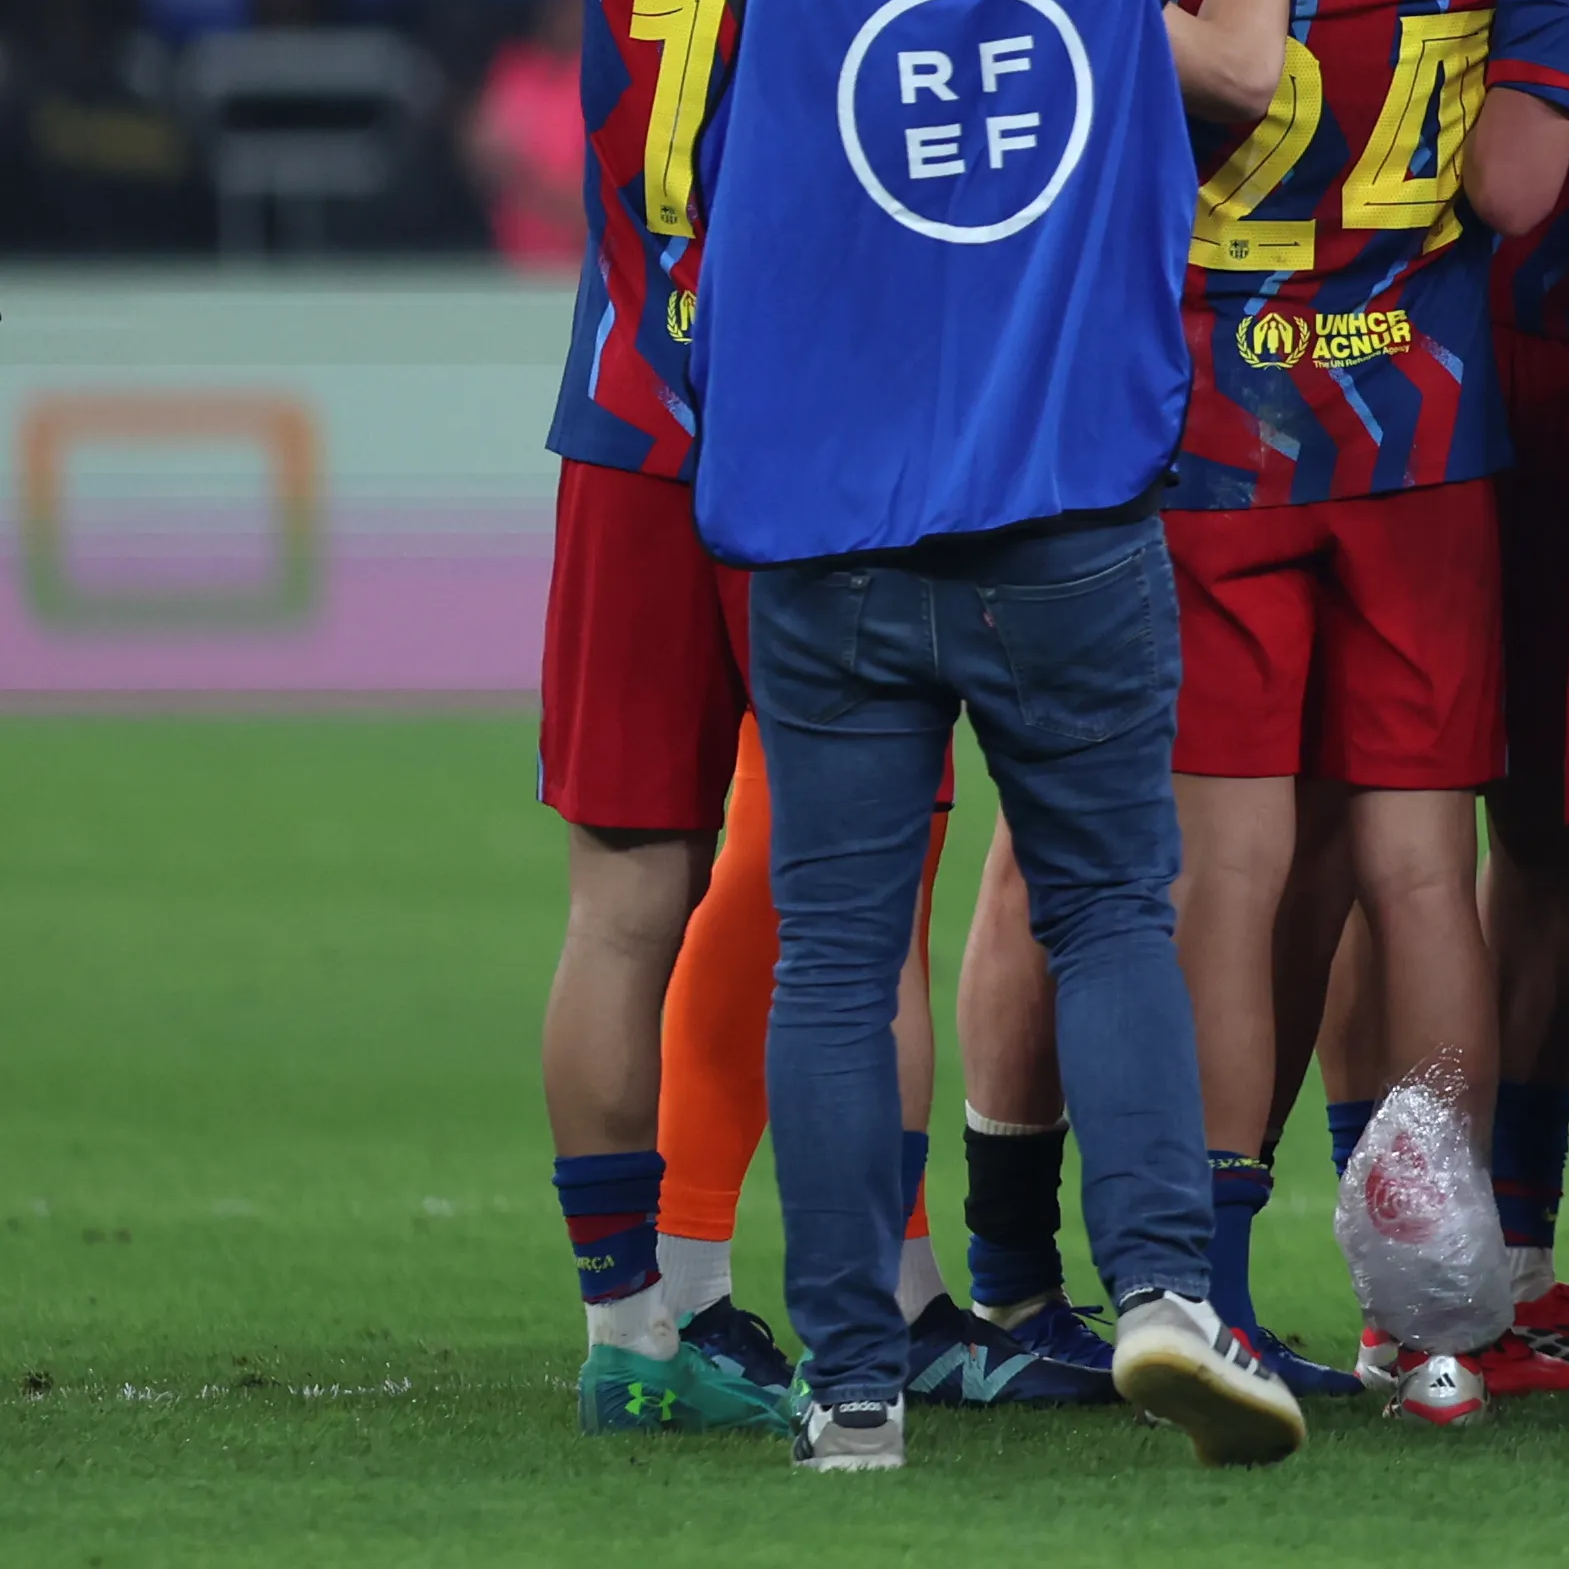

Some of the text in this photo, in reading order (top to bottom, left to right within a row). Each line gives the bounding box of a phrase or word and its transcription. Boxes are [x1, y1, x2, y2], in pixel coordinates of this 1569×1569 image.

[1188, 8, 1495, 271] 24
[1312, 321, 1412, 359] ACNUR
[1315, 309, 1408, 336] UNHCR
